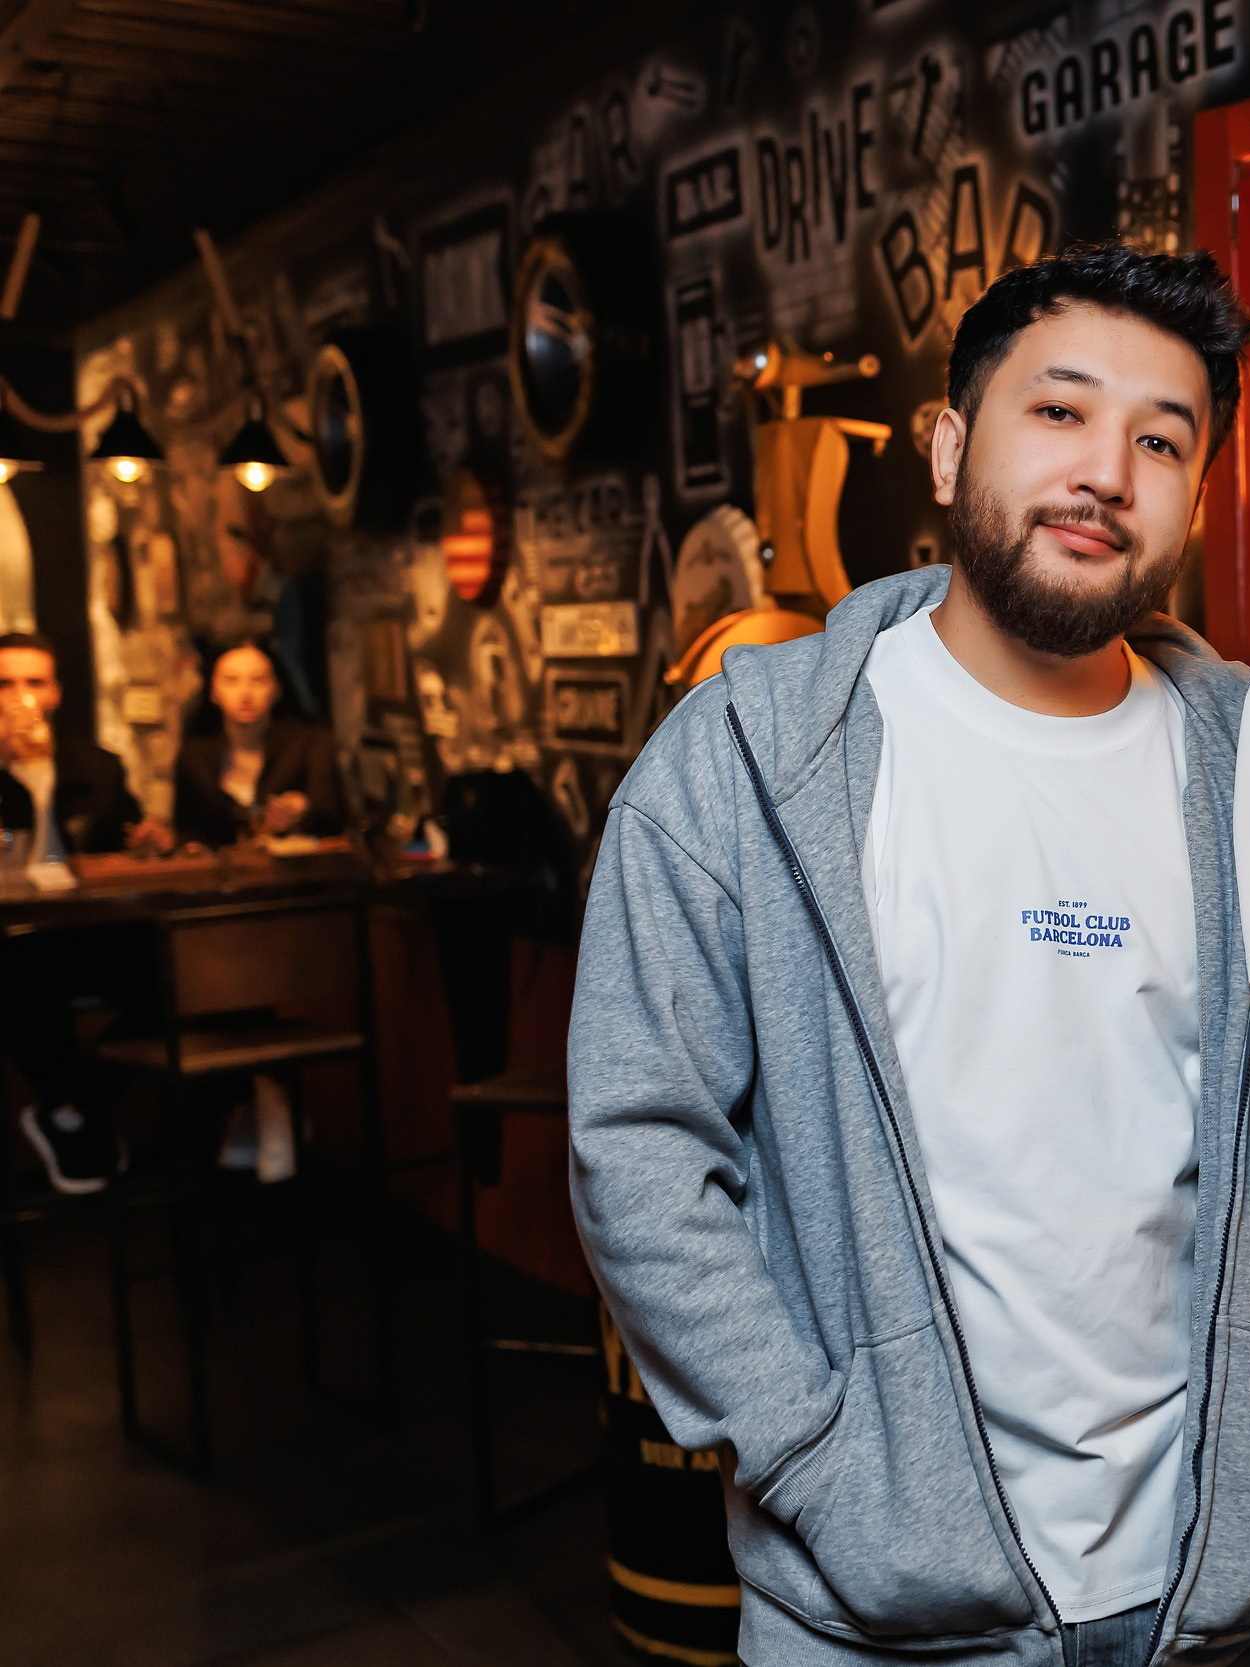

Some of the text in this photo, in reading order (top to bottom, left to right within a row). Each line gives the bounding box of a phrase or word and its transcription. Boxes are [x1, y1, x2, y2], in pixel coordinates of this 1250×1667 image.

[1021, 0, 1236, 136] GARAGE
[757, 84, 876, 265] DRIVE
[1021, 910, 1131, 931] FUTBOL CLUB
[1030, 927, 1123, 947] BARCELONA
